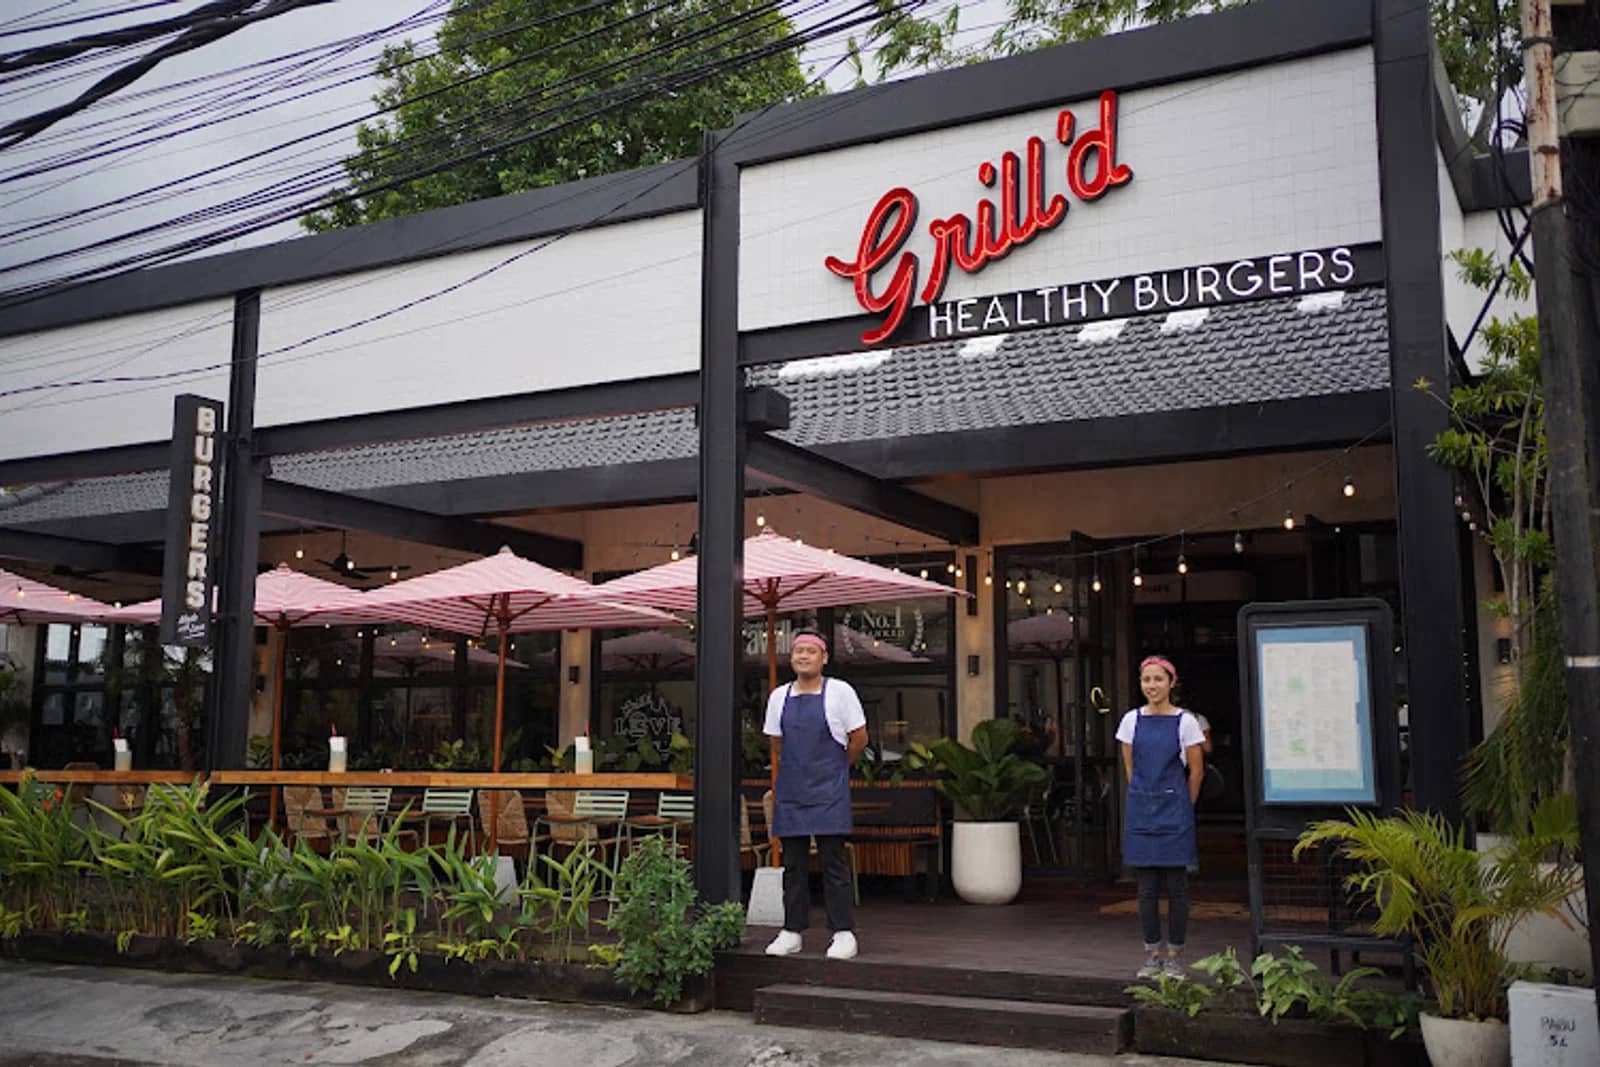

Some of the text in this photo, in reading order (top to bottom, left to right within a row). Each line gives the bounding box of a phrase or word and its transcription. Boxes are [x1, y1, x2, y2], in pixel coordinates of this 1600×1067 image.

[825, 89, 1133, 345] Grill'd
[929, 248, 1355, 338] HEALTHY BURGERS
[186, 407, 216, 609] BURGERS
